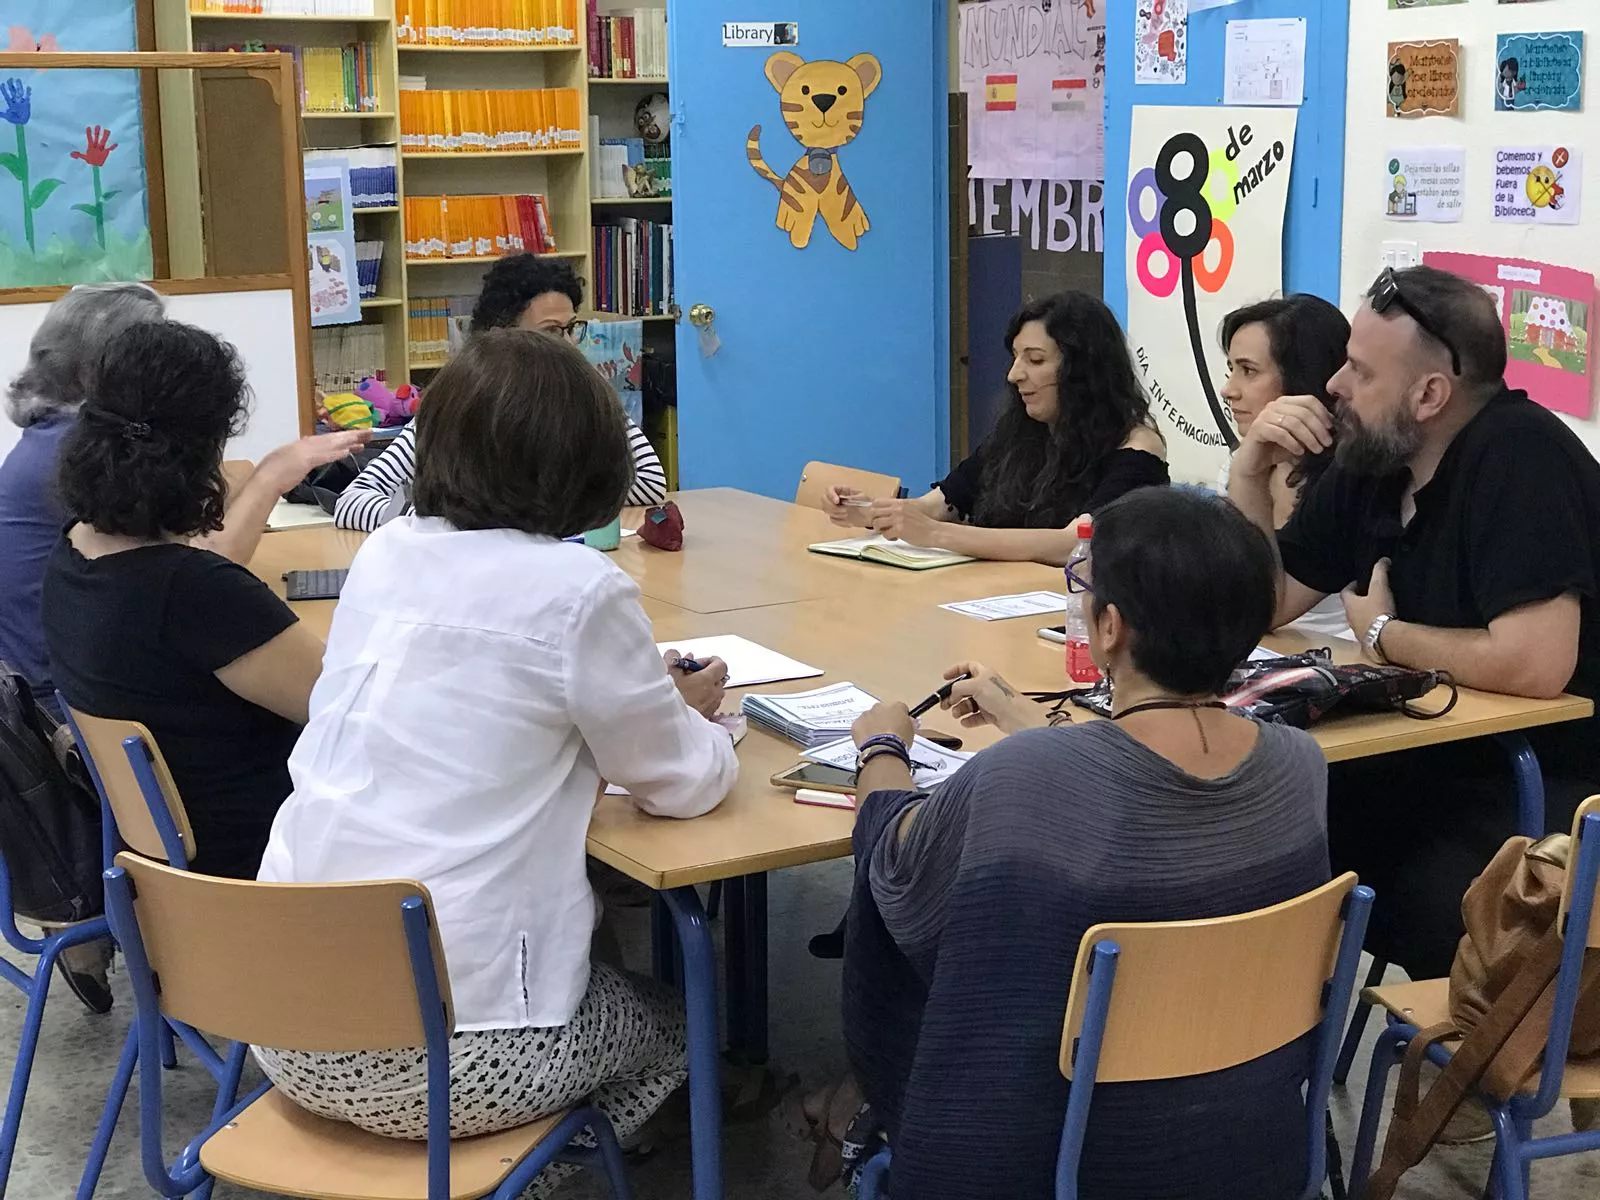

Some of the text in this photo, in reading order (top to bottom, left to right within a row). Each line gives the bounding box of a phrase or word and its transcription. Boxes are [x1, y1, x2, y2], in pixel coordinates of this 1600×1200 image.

[724, 24, 773, 43] Library
[1496, 151, 1543, 163] Comemos y
[1433, 162, 1442, 173] las
[1443, 161, 1460, 173] sillas
[1496, 164, 1531, 175] bebemos
[1440, 177, 1460, 185] como
[1496, 178, 1518, 189] fuera
[1155, 124, 1284, 258] 8 de marzo
[1495, 191, 1515, 203] de la
[1437, 198, 1462, 209] de salir
[1494, 205, 1536, 217] Biblioteca
